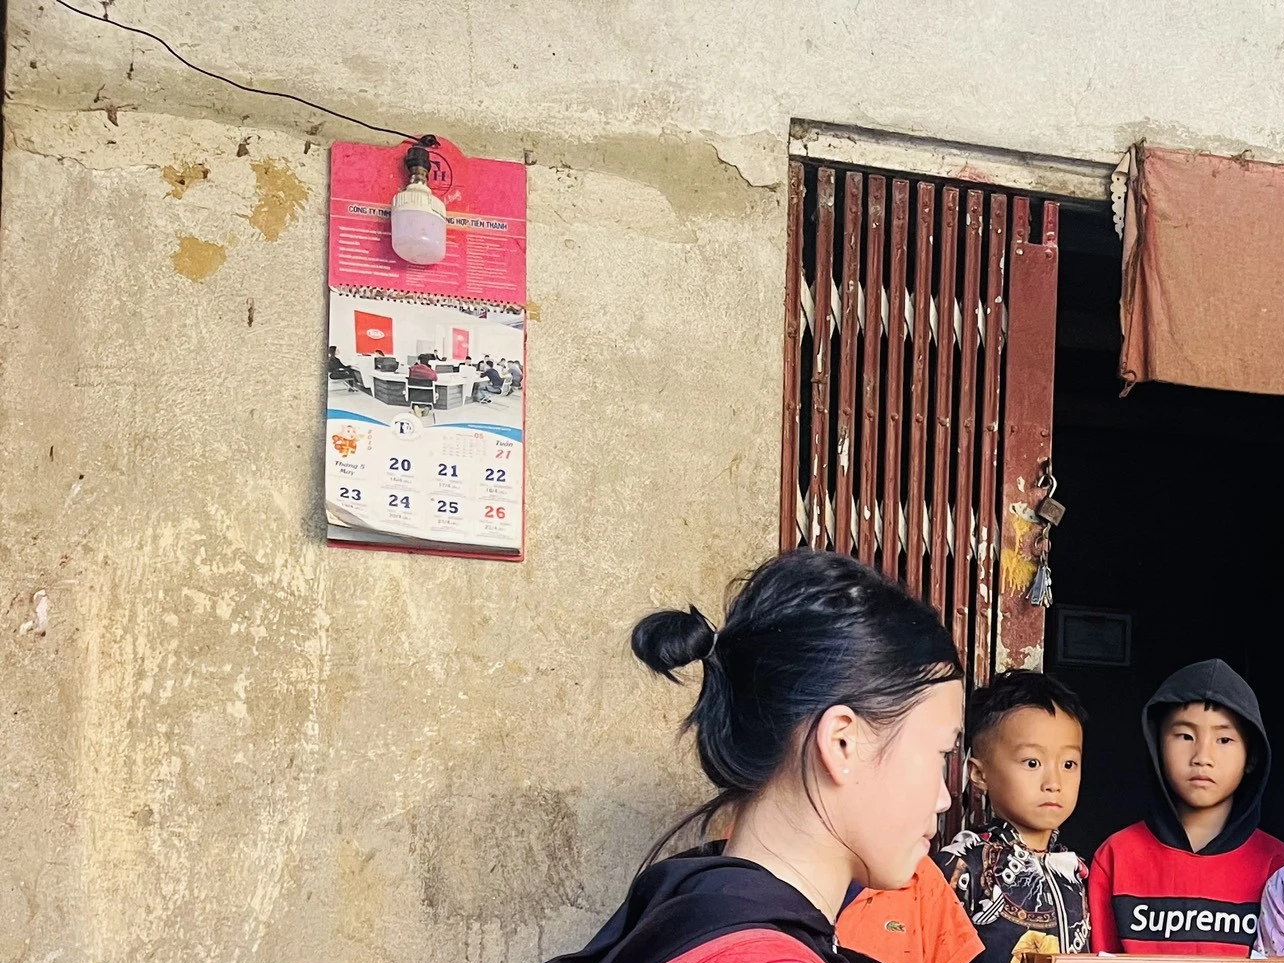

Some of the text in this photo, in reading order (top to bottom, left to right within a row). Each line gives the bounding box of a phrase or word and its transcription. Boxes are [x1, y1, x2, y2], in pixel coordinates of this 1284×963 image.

[348, 204, 368, 215] CÔNG
[495, 449, 512, 460] 21
[340, 468, 355, 476] May
[389, 457, 506, 482] 20 21 22
[339, 487, 506, 519] 23 24 25 26
